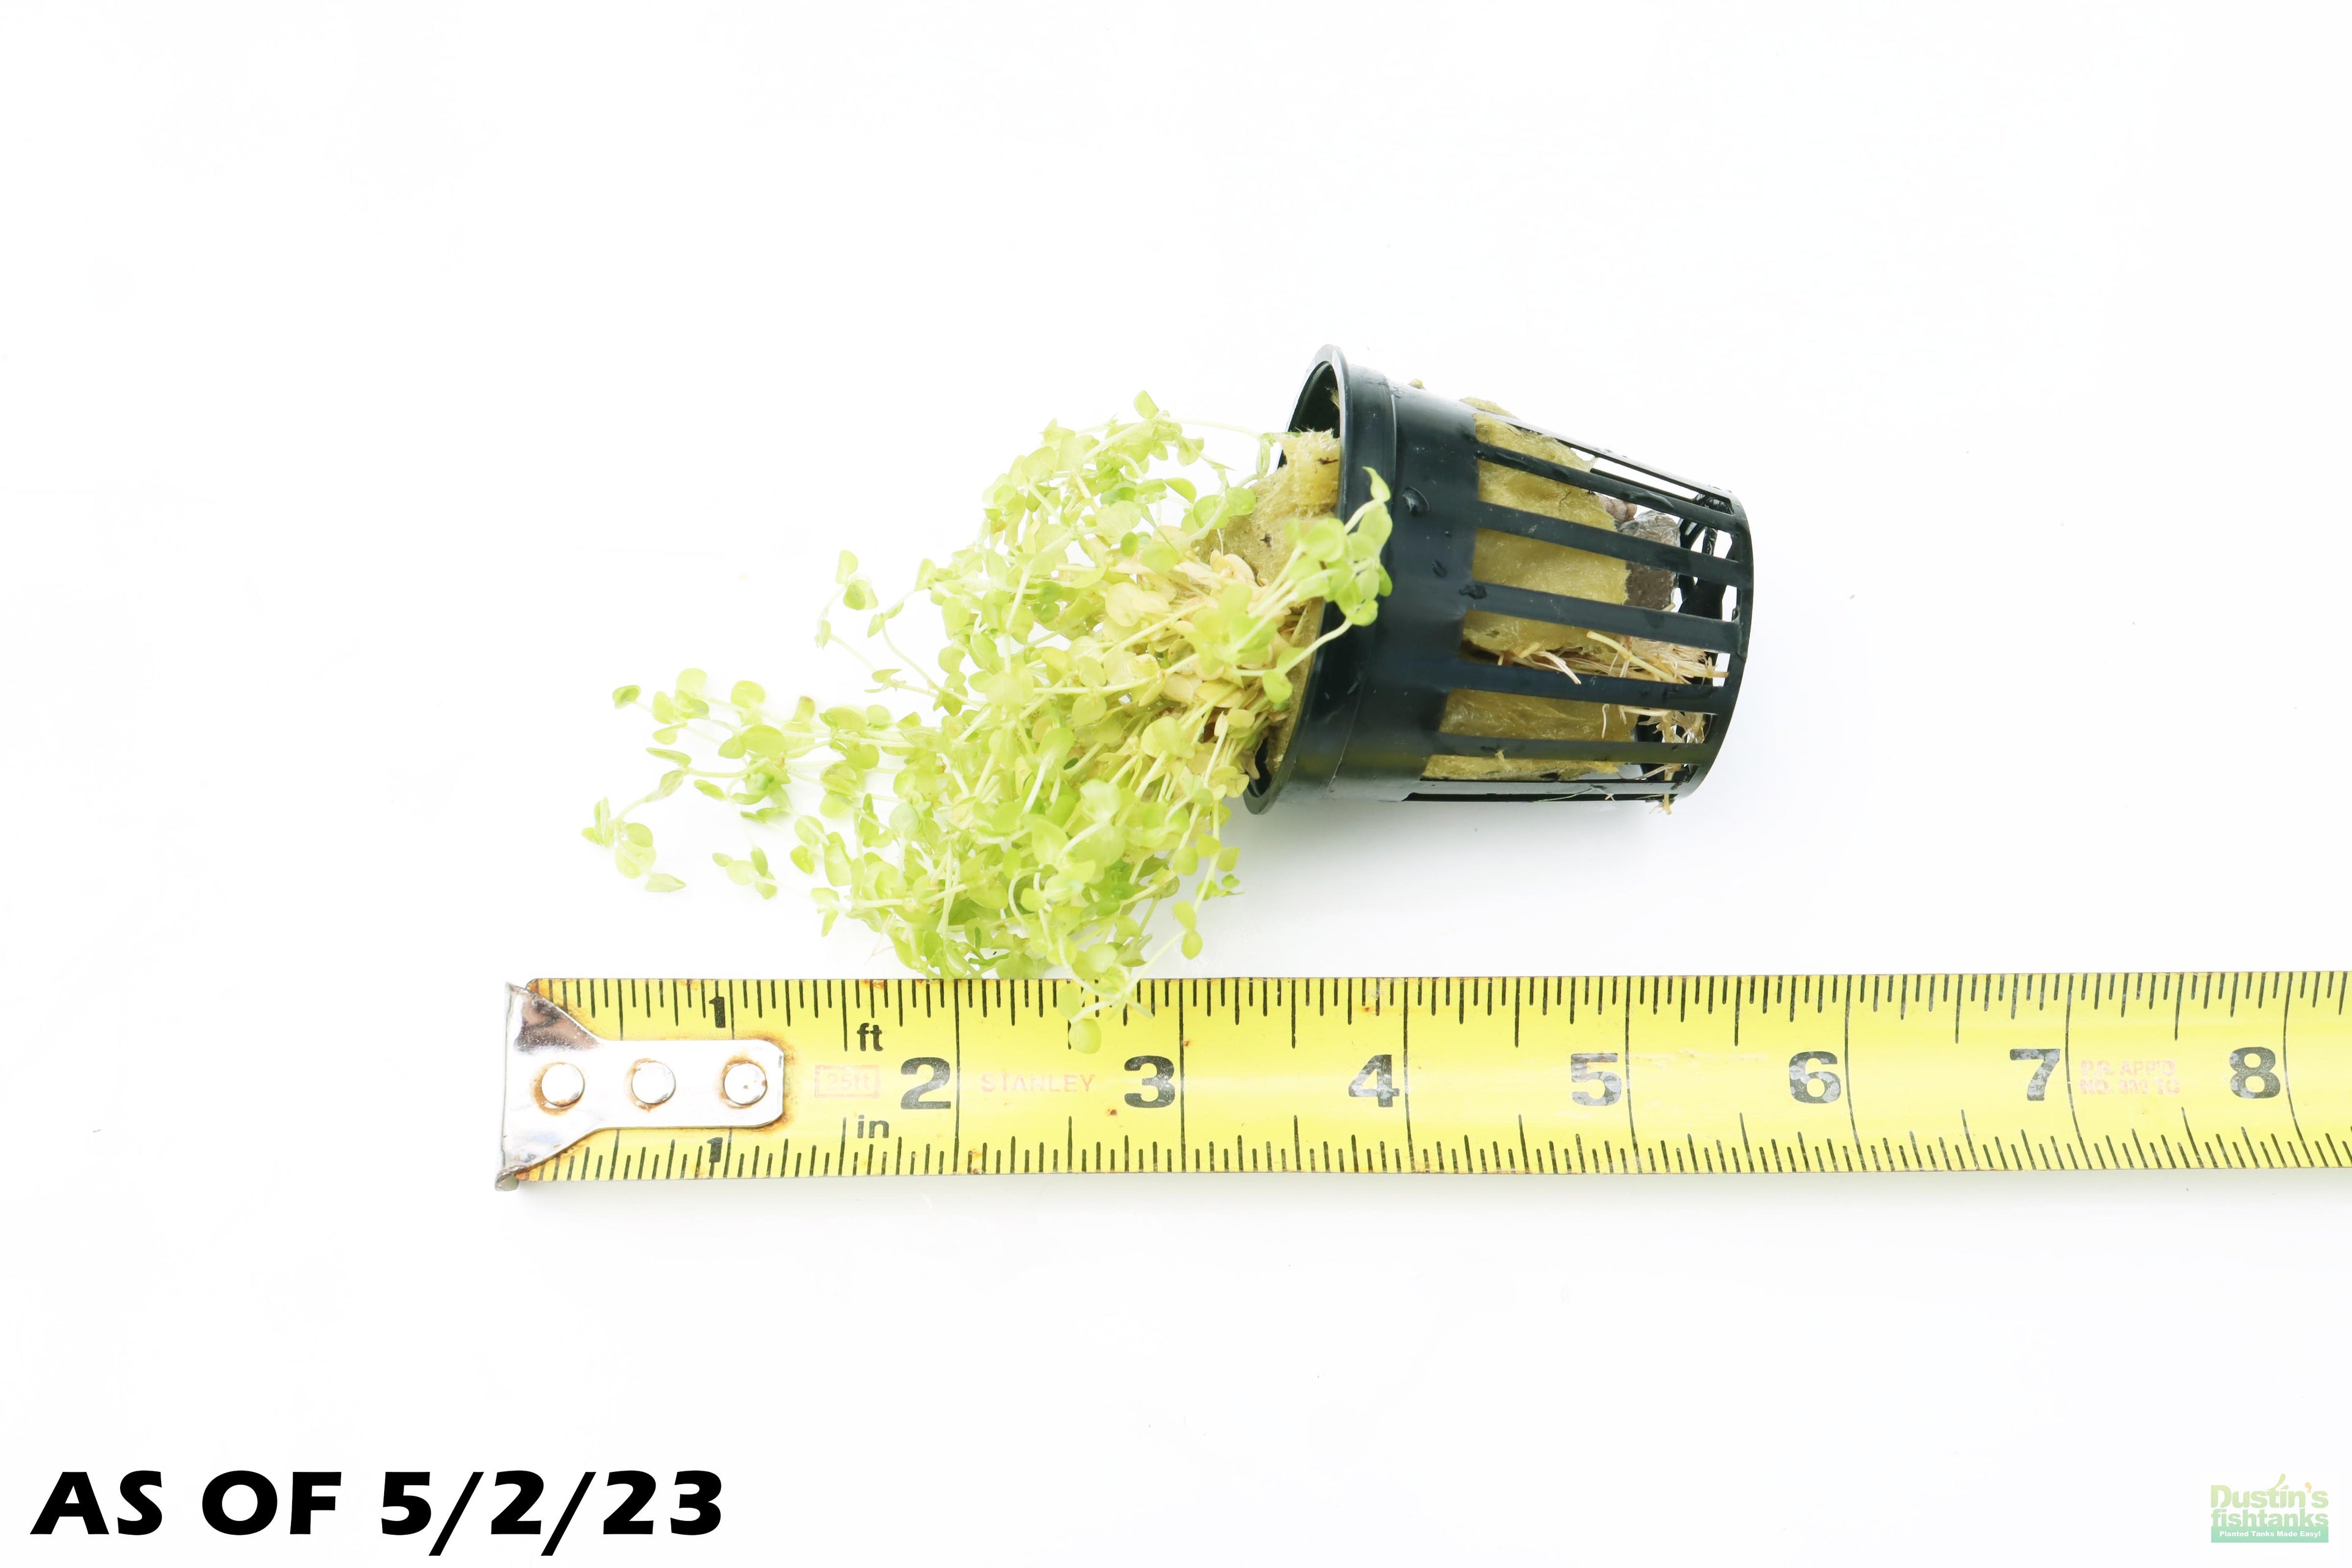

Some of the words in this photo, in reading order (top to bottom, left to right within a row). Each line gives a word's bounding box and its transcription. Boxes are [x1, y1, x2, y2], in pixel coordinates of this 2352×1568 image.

[708, 996, 726, 1028] 1
[857, 1022, 884, 1052] ft
[901, 1057, 951, 1109] 2
[981, 1074, 1095, 1093] STANLEY
[1125, 1055, 1175, 1108] 3
[1349, 1054, 1400, 1107] 4
[1571, 1053, 1621, 1106] 5
[1789, 1051, 1841, 1104] 6
[2010, 1049, 2060, 1101] 7
[2230, 1047, 2280, 1099] 8
[706, 1137, 723, 1163] 1
[858, 1115, 889, 1139] in
